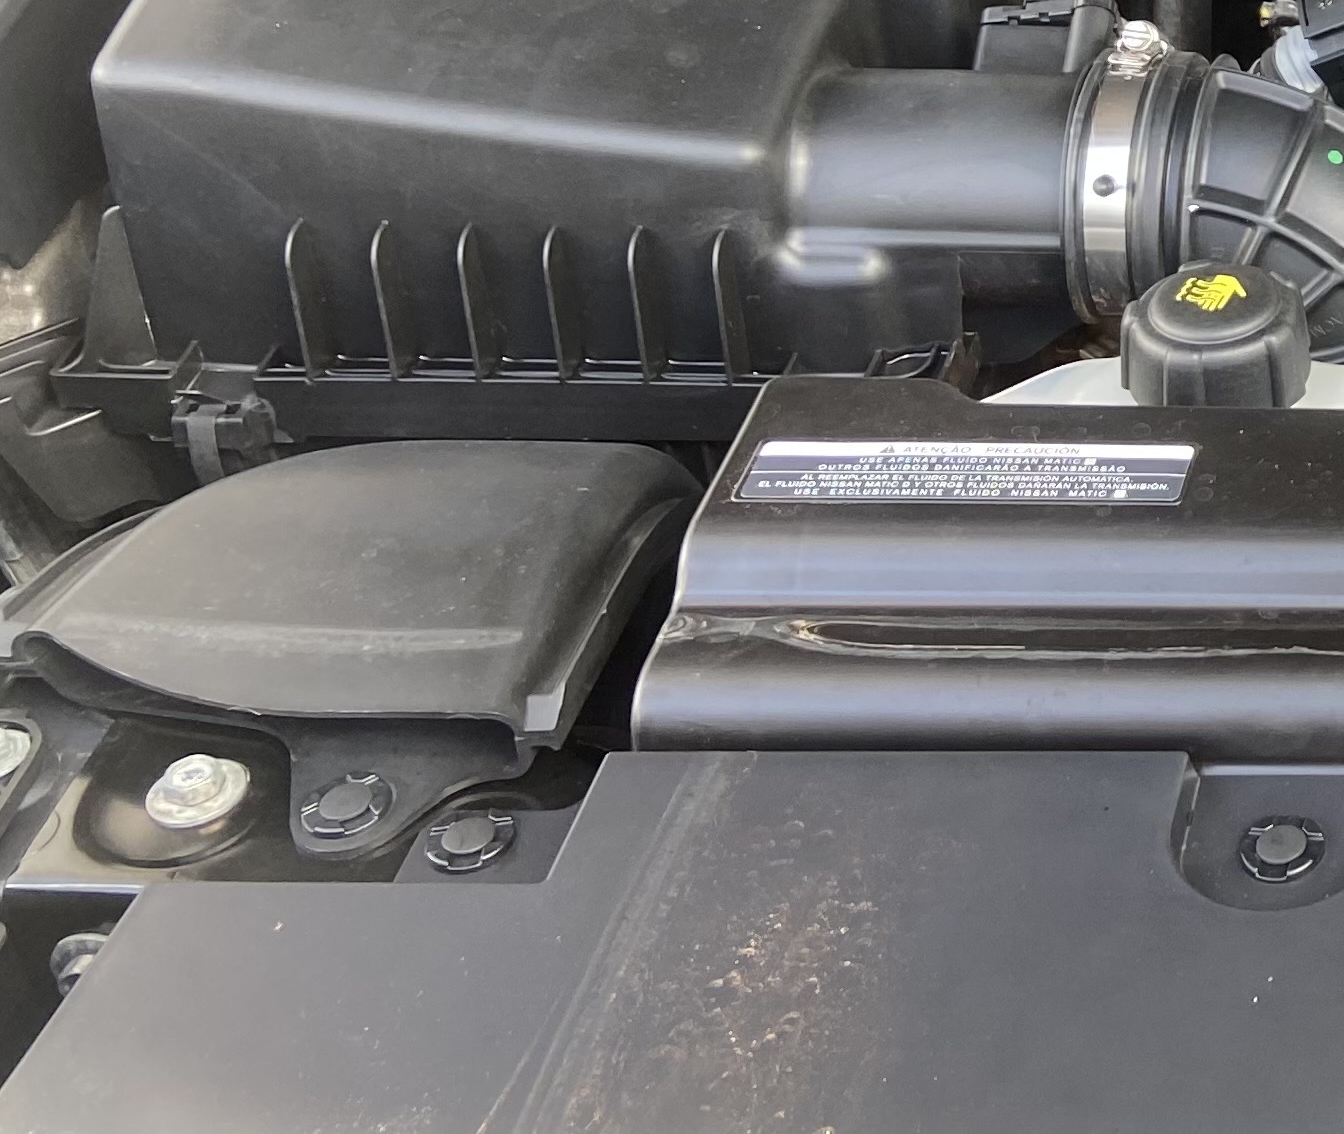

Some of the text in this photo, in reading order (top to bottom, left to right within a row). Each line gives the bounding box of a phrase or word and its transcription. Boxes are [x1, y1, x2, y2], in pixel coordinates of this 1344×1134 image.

[986, 446, 1080, 455] PRECAUCIÓN
[859, 456, 884, 464] USE
[888, 456, 938, 464] APENAS
[818, 463, 870, 471] OUTROS
[934, 463, 1019, 472] DANIFICARÃO
[1037, 464, 1126, 473] TRANSMISSÃO
[818, 473, 890, 481] REEMPLAZAR
[985, 474, 1060, 482] TRANSMISIÓN
[775, 480, 816, 488] FLUIDO
[819, 480, 862, 488] NISSAN
[966, 481, 1014, 489] FLUIDOS
[1074, 482, 1088, 490] LA
[829, 488, 945, 496] EXCLUSIVAMENTE
[953, 488, 1001, 496] FLUIDO
[1010, 489, 1059, 497] NISSAN
[1068, 489, 1108, 497] MATIC
